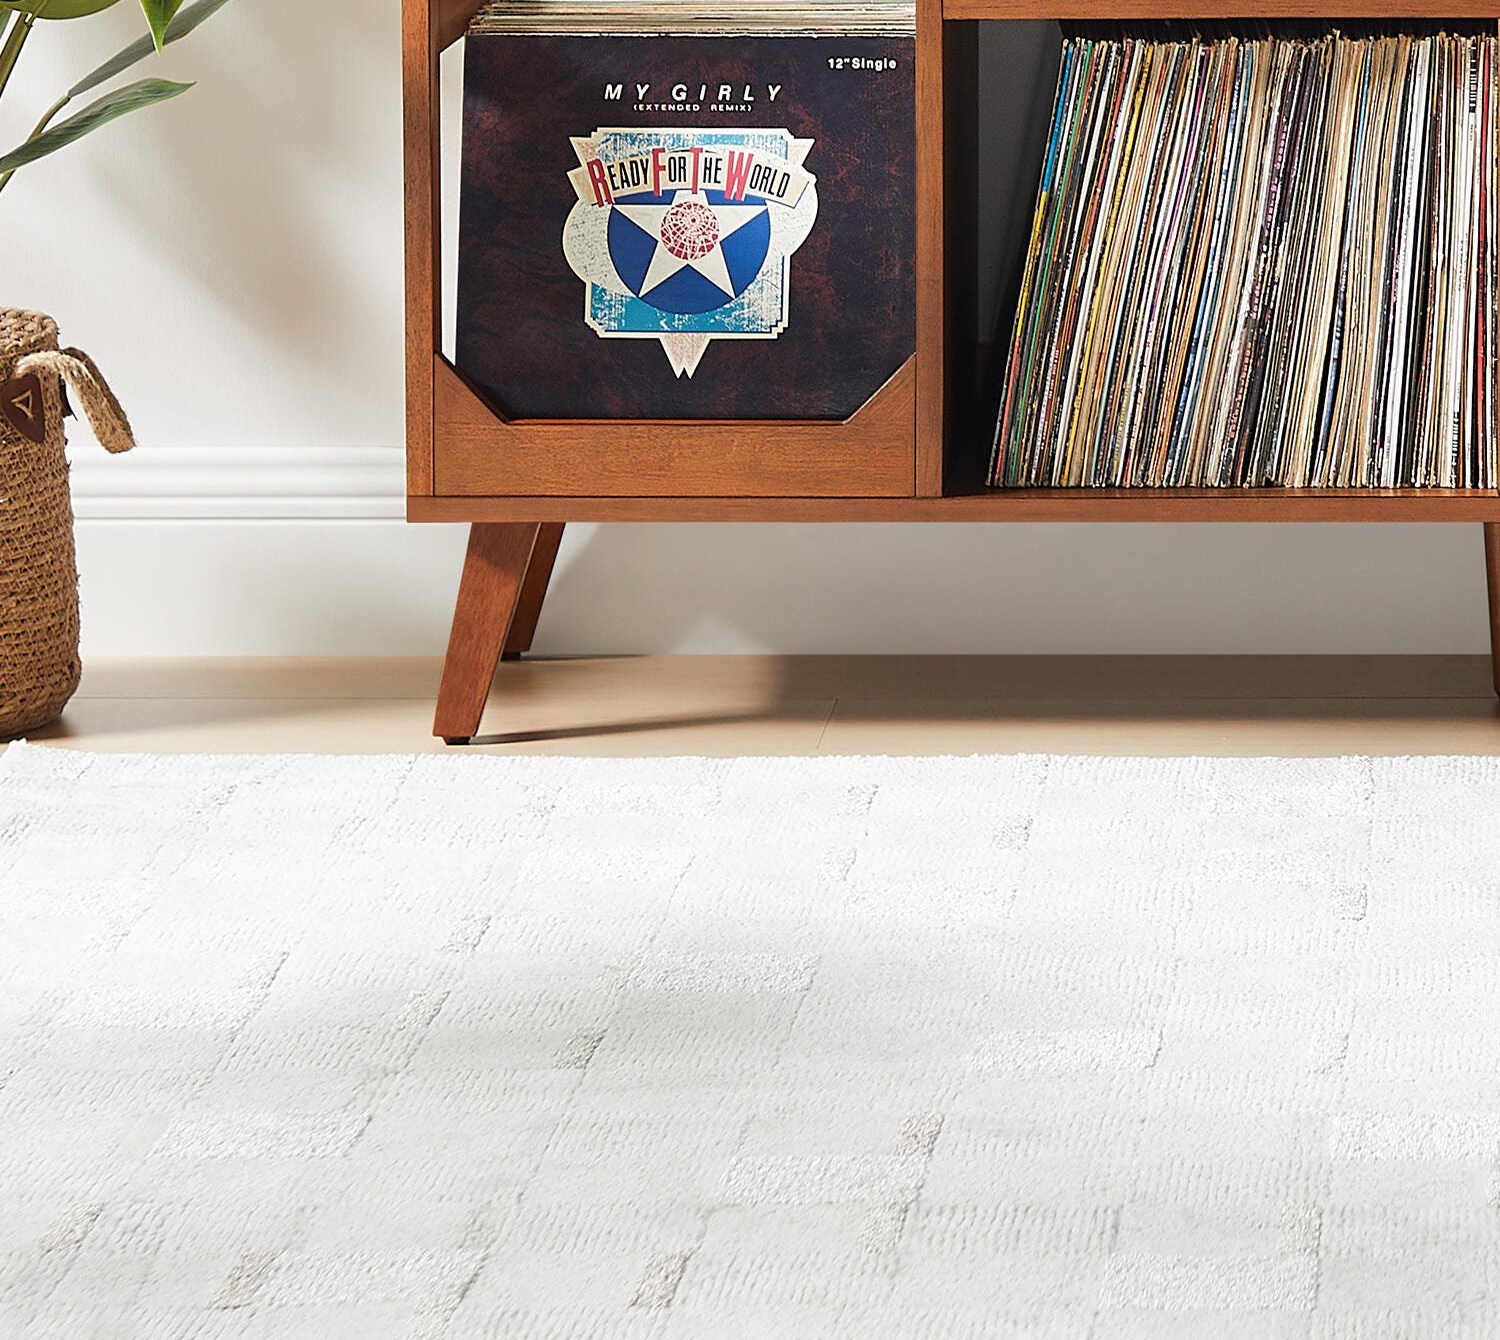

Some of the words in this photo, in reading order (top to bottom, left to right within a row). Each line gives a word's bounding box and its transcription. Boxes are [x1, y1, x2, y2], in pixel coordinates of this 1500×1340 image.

[604, 83, 650, 101] MY
[671, 83, 782, 102] GIRLY
[633, 103, 700, 112] (EXTENDED
[710, 103, 753, 112] REMIX)
[586, 158, 649, 207] READY
[652, 147, 687, 197] FOR
[689, 147, 722, 195] THE
[723, 150, 791, 202] WORLD
